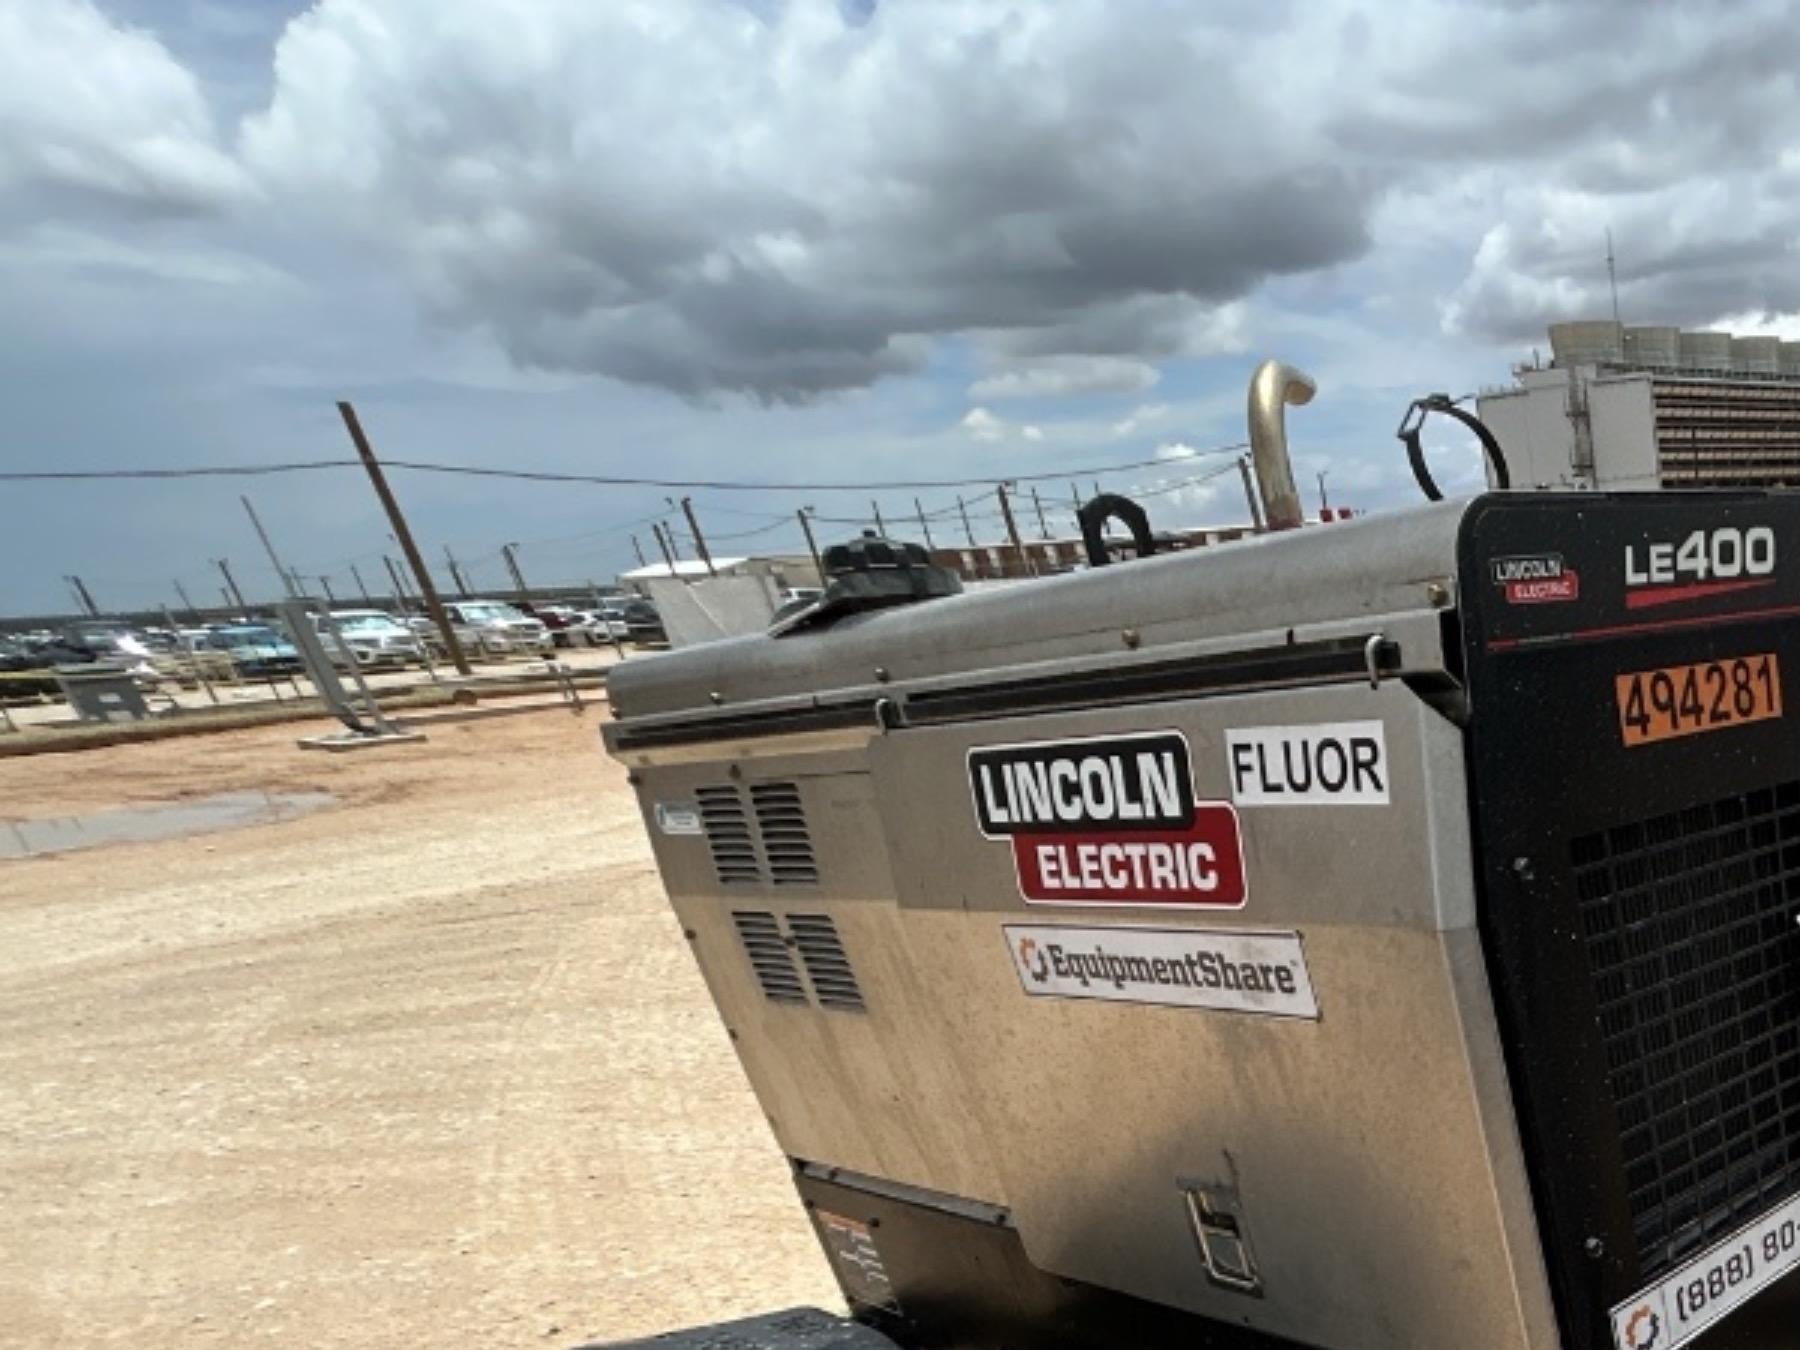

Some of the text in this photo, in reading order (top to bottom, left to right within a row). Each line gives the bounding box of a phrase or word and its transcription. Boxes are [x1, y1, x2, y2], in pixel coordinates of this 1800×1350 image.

[1625, 527, 1776, 586] LE400
[1623, 661, 1777, 736] 494281
[979, 751, 1183, 825] LINCOLN
[1231, 737, 1384, 795] FLUOR
[1036, 842, 1219, 891] ELECTRIC
[1046, 944, 1297, 994] EquipmentShare
[1676, 1244, 1754, 1321] (888)
